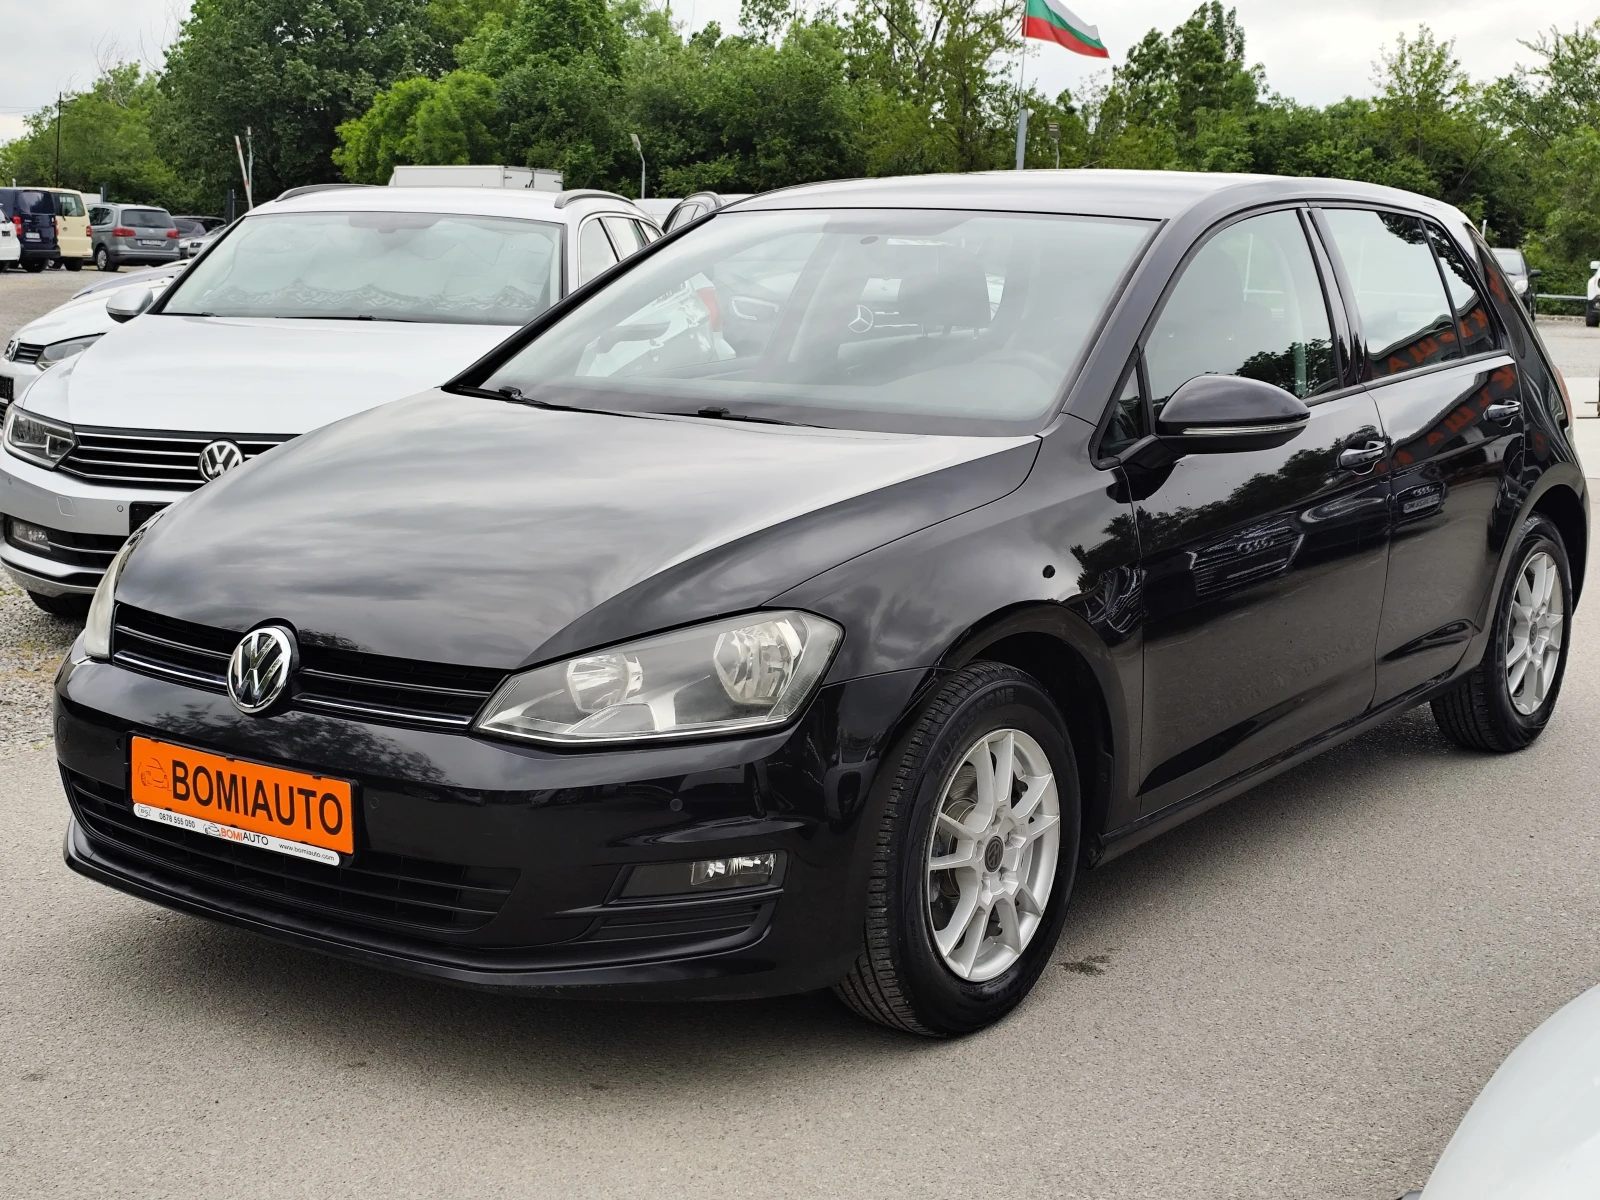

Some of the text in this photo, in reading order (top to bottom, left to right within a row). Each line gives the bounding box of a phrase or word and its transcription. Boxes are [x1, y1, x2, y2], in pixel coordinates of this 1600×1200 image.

[172, 759, 343, 836] BOMIAUTO
[173, 816, 184, 825] 555
[184, 819, 196, 828] 050
[220, 827, 269, 846] BOMIAUTO
[278, 843, 335, 862] www.bomiauto.com
